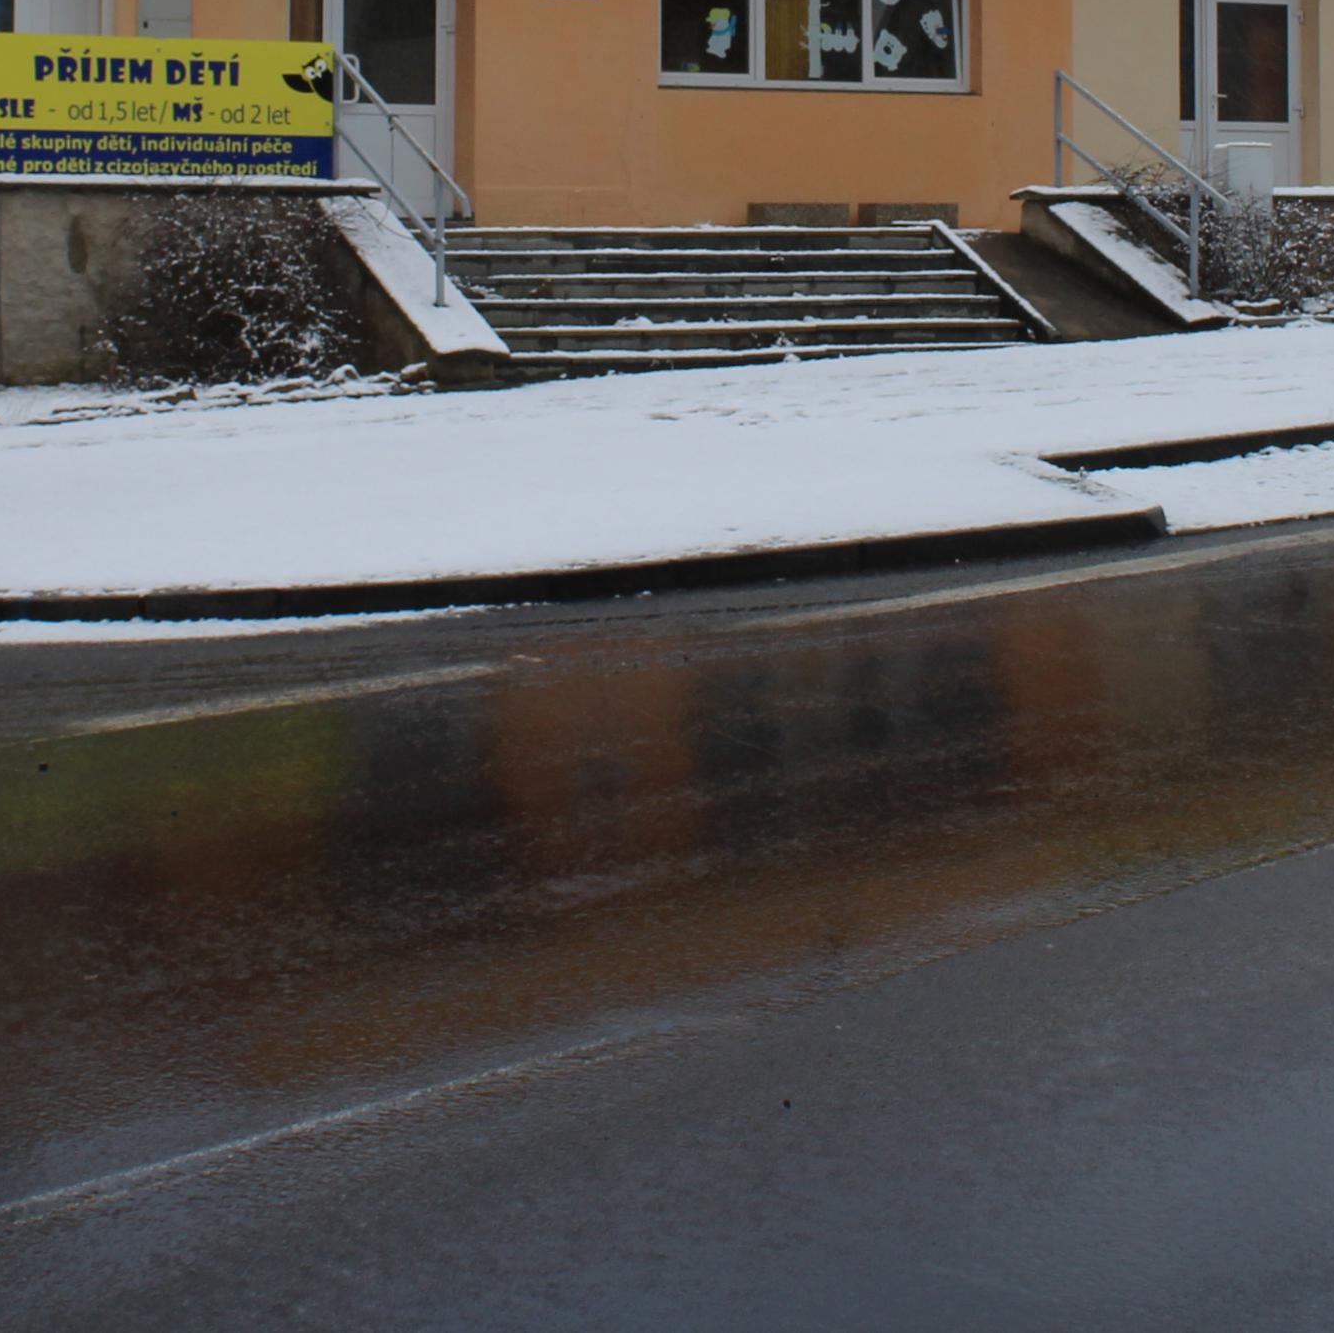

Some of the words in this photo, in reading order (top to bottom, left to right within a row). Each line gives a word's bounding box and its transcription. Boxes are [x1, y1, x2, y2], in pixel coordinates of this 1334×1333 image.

[34, 47, 153, 84] PŘÍJEM
[165, 52, 240, 87] DĚTÍ
[68, 101, 94, 120] od
[98, 101, 127, 124] 1,5
[173, 96, 203, 122] MŠ
[220, 104, 245, 124] od
[250, 104, 262, 124] 2
[267, 105, 291, 125] let
[21, 134, 93, 153] skupiny
[141, 136, 248, 153] individuální
[251, 137, 293, 156] péče
[23, 160, 54, 174] pro
[56, 157, 91, 172] děti
[94, 161, 105, 172] z
[106, 158, 233, 175] cizojazyčného
[236, 160, 318, 176] prostředí
